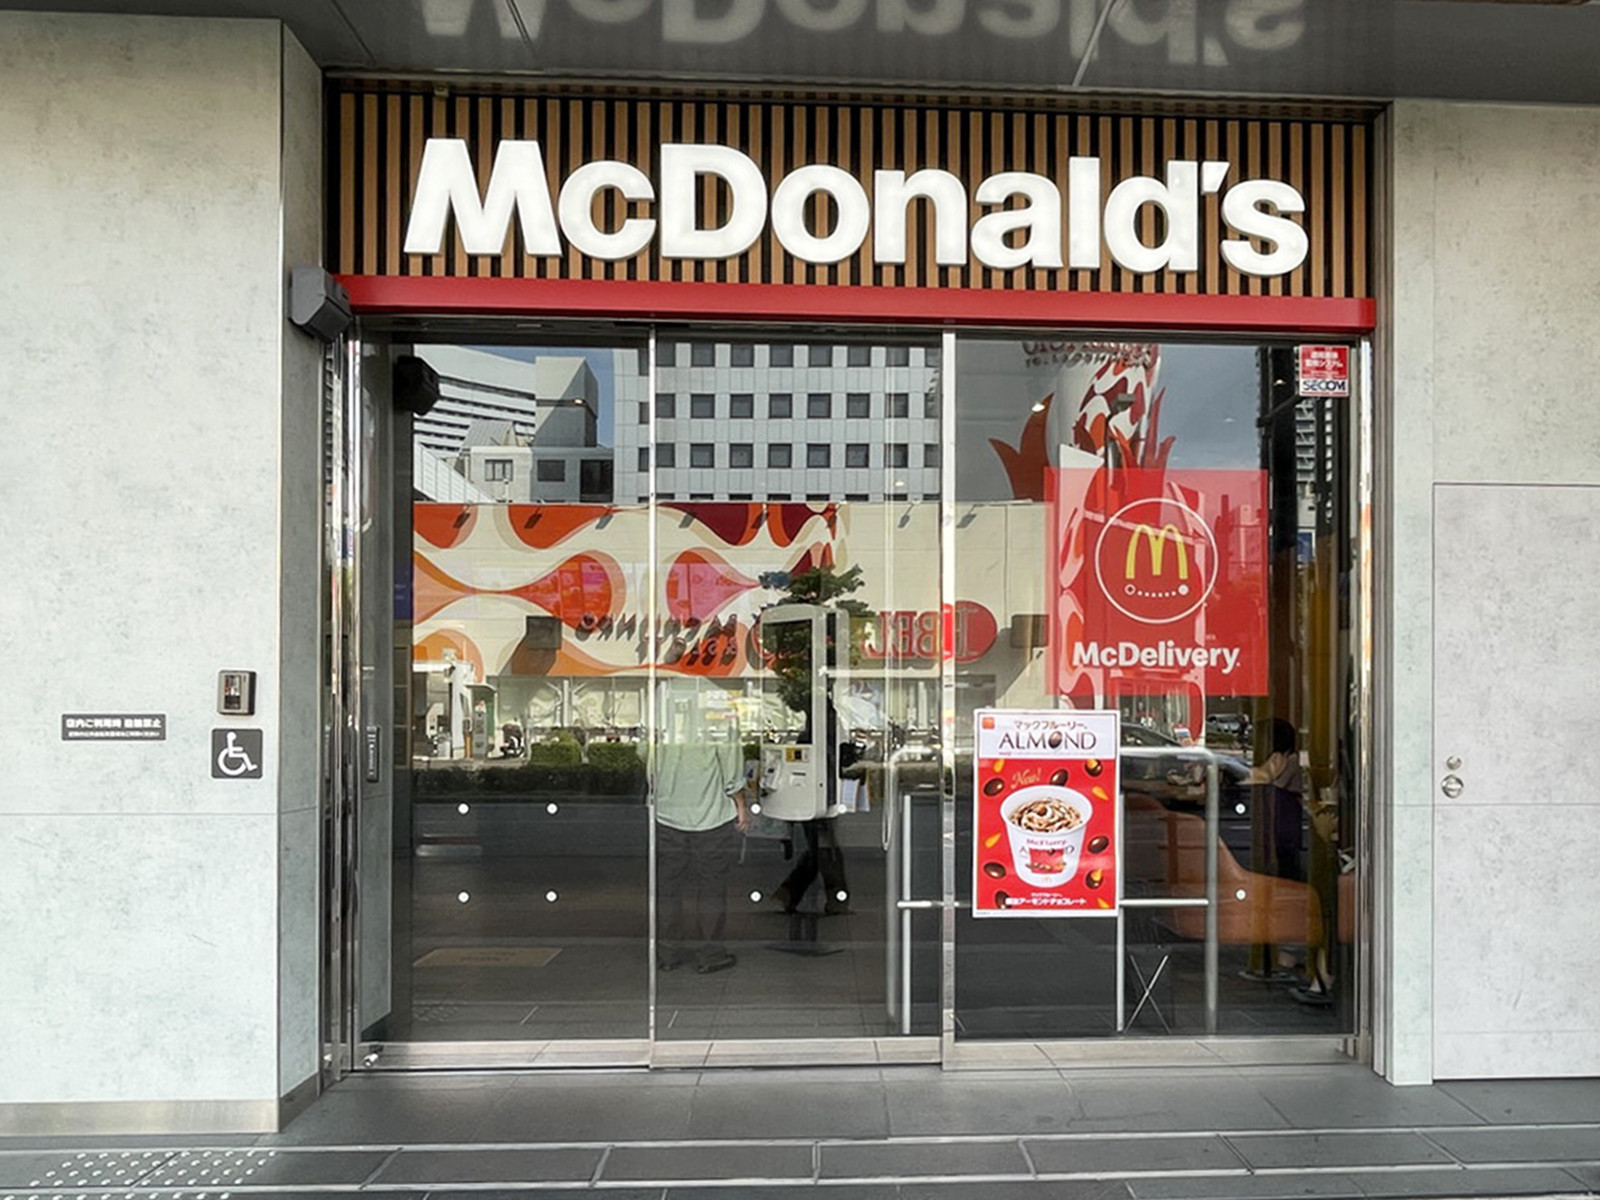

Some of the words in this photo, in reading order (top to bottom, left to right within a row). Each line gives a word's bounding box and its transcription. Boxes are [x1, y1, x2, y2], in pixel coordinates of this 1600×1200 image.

[403, 137, 1310, 278] McDonald's
[1302, 380, 1346, 391] SECOM
[998, 730, 1097, 750] ALMOND
